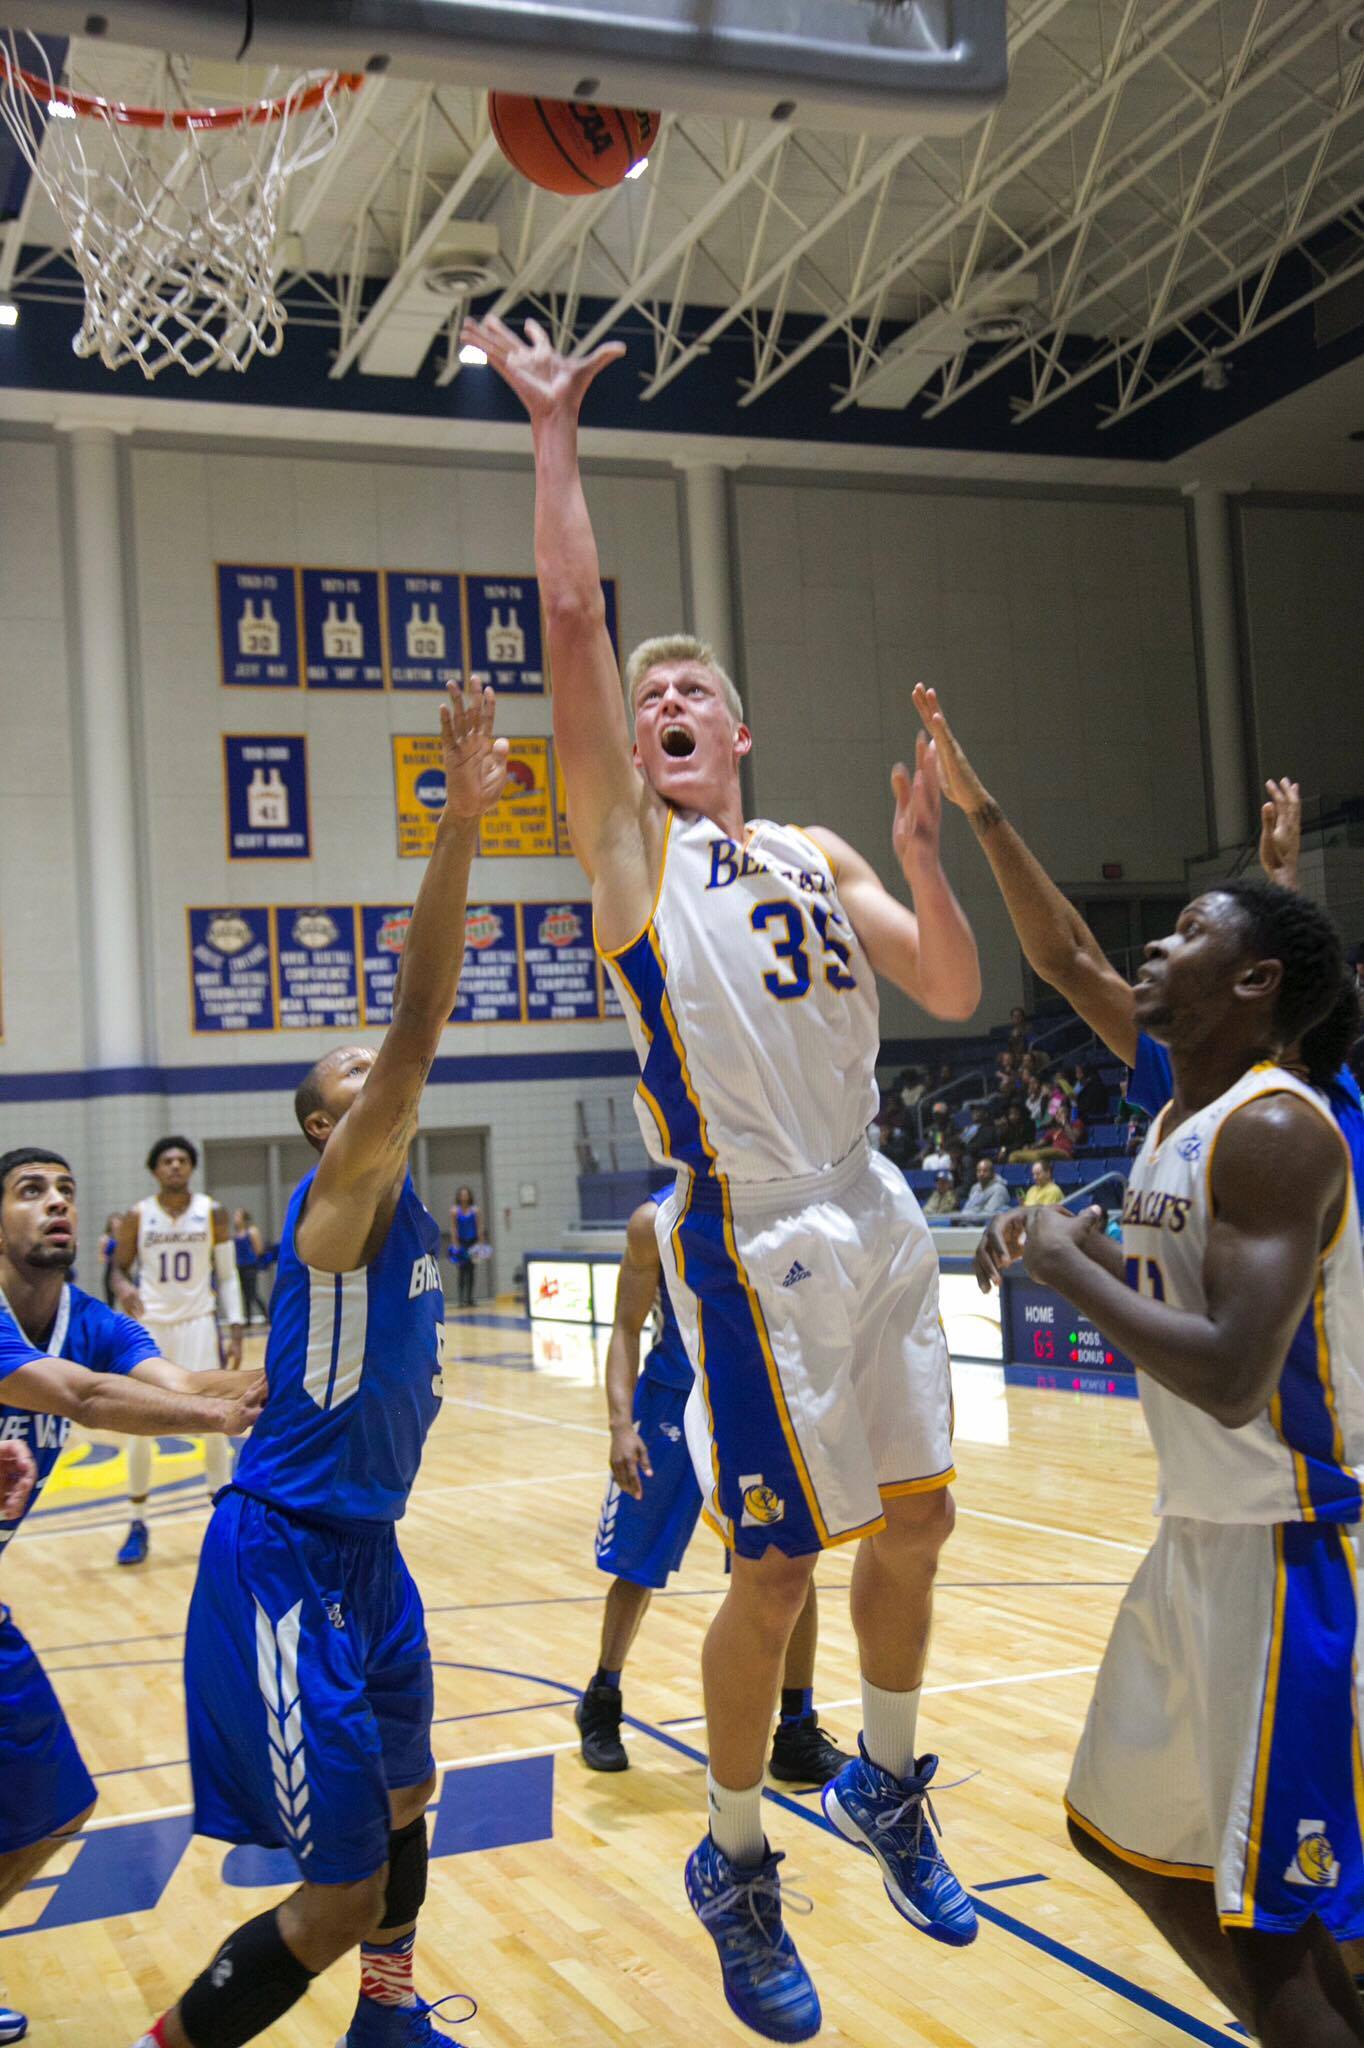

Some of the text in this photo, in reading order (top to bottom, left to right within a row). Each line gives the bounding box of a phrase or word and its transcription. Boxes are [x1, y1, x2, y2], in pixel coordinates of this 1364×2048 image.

[334, 638, 353, 654] 31
[495, 643, 517, 659] 33
[159, 1250, 191, 1283] 10
[1024, 1305, 1055, 1324] HOME
[1077, 1349, 1105, 1365] BONUS
